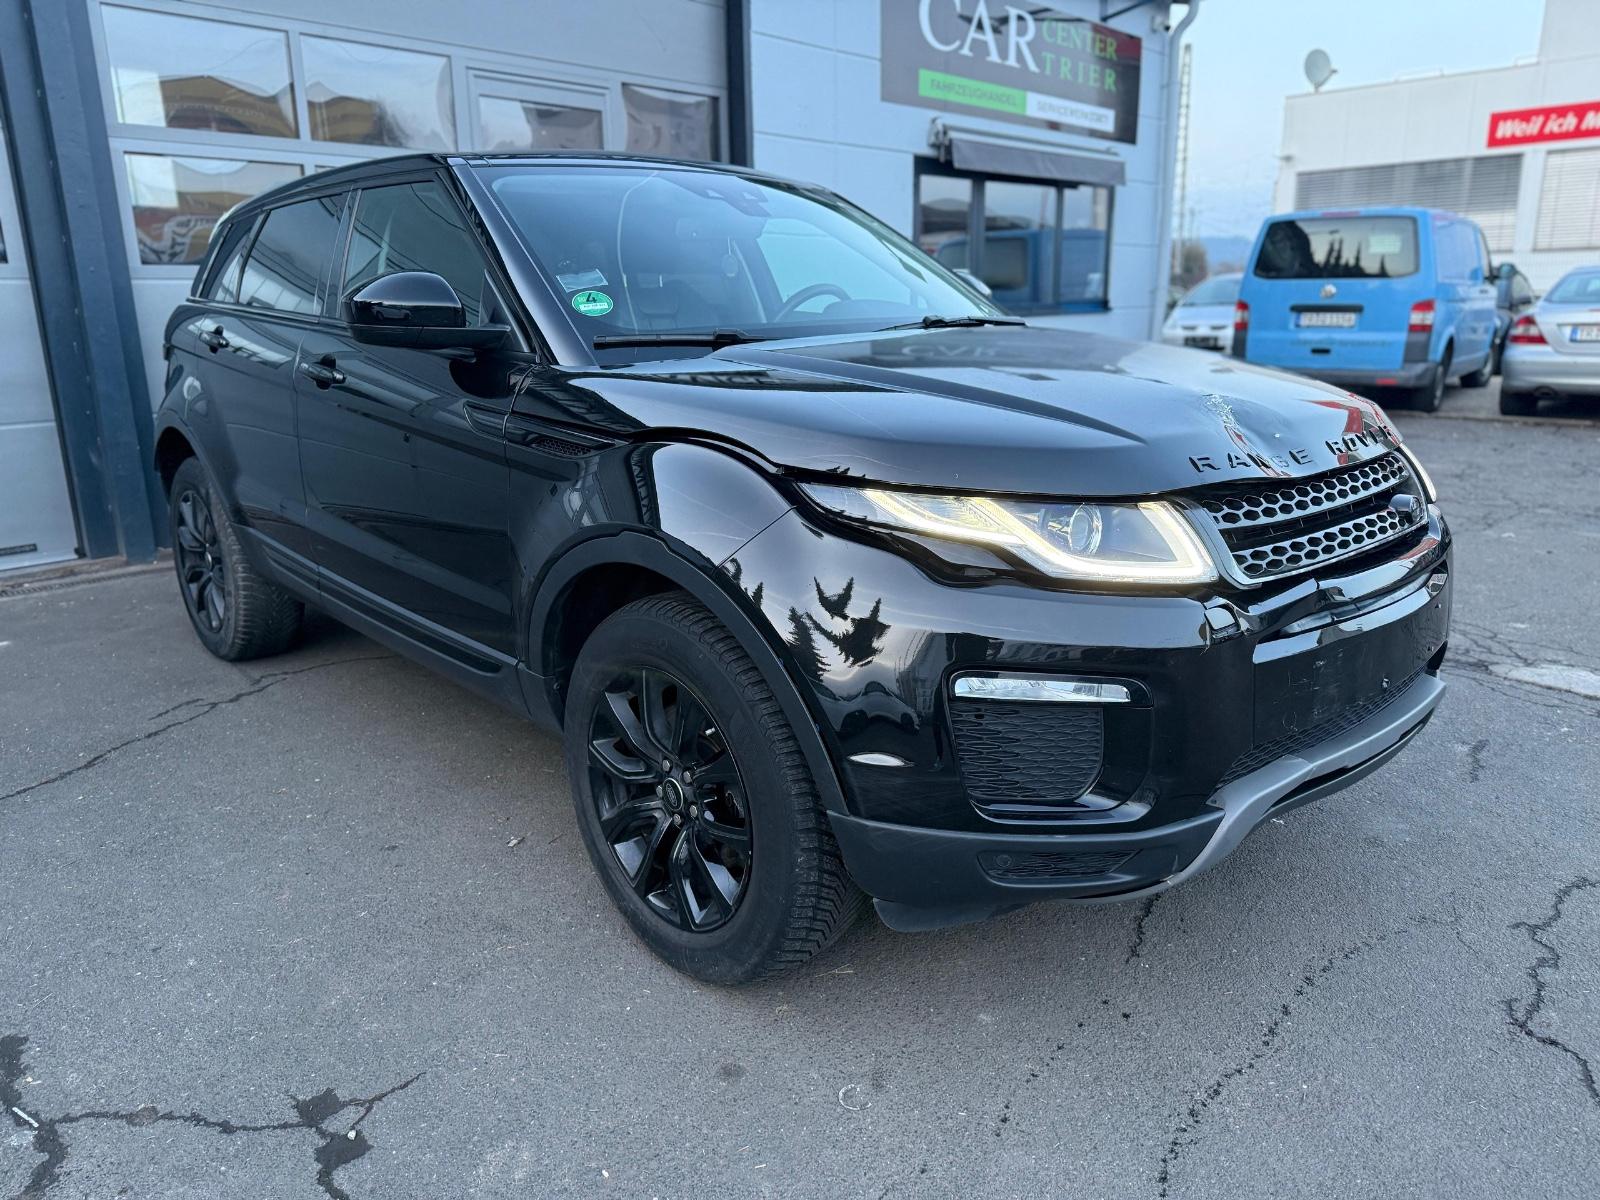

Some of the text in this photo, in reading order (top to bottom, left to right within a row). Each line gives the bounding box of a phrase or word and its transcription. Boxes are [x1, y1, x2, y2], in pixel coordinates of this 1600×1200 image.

[918, 0, 1040, 73] CAR
[1042, 18, 1117, 61] CENTER
[1042, 51, 1117, 92] TRIER
[1496, 115, 1543, 138] Weil
[1545, 112, 1577, 134] ich
[1188, 447, 1314, 473] RANGE
